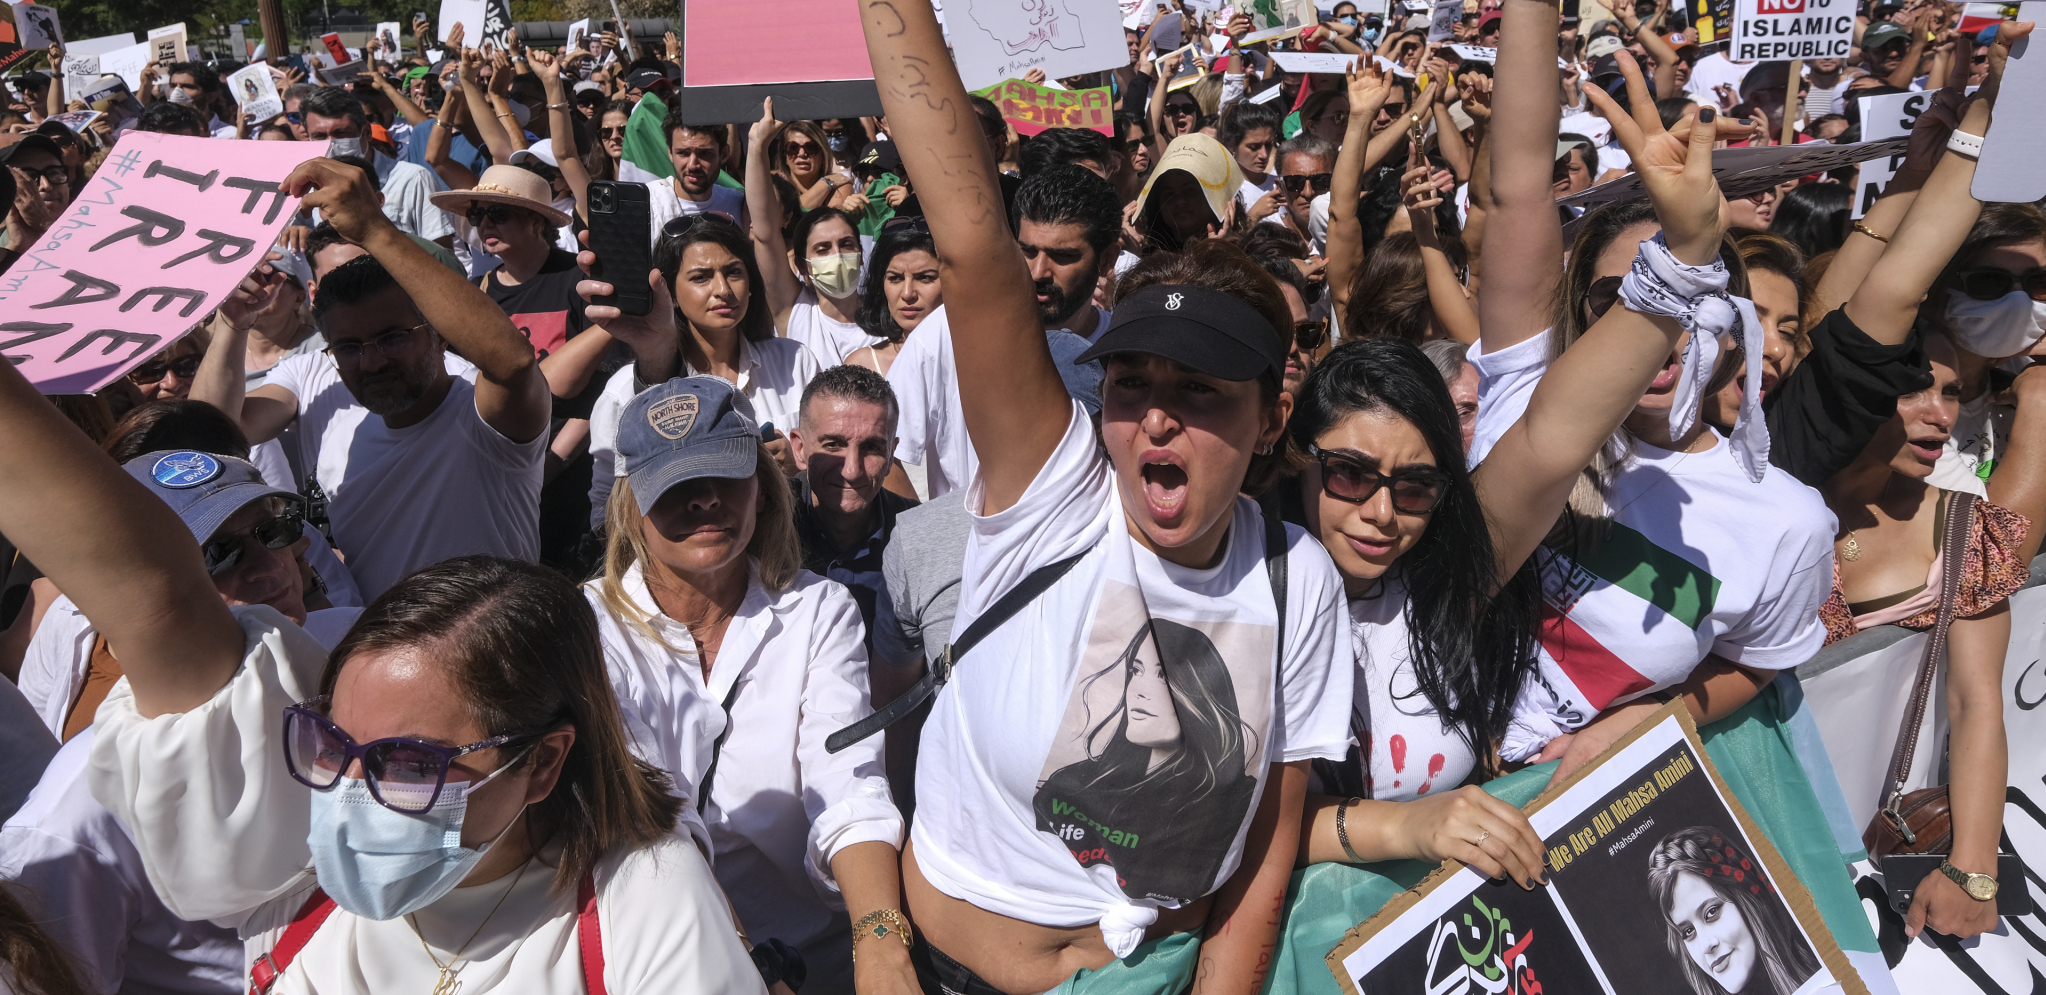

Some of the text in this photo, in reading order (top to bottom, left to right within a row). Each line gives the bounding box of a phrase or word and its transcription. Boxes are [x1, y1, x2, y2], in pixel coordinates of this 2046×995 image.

[1743, 16, 1852, 37] ISLAMIC
[1740, 40, 1849, 59] REPUBLIC
[54, 176, 288, 363] FREE
[651, 402, 696, 424] NORTH SHORE
[1052, 798, 1140, 849] Woman
[1549, 750, 1695, 873] We Are All Mahsa Amini
[1608, 816, 1655, 857] #MahsaAmini
